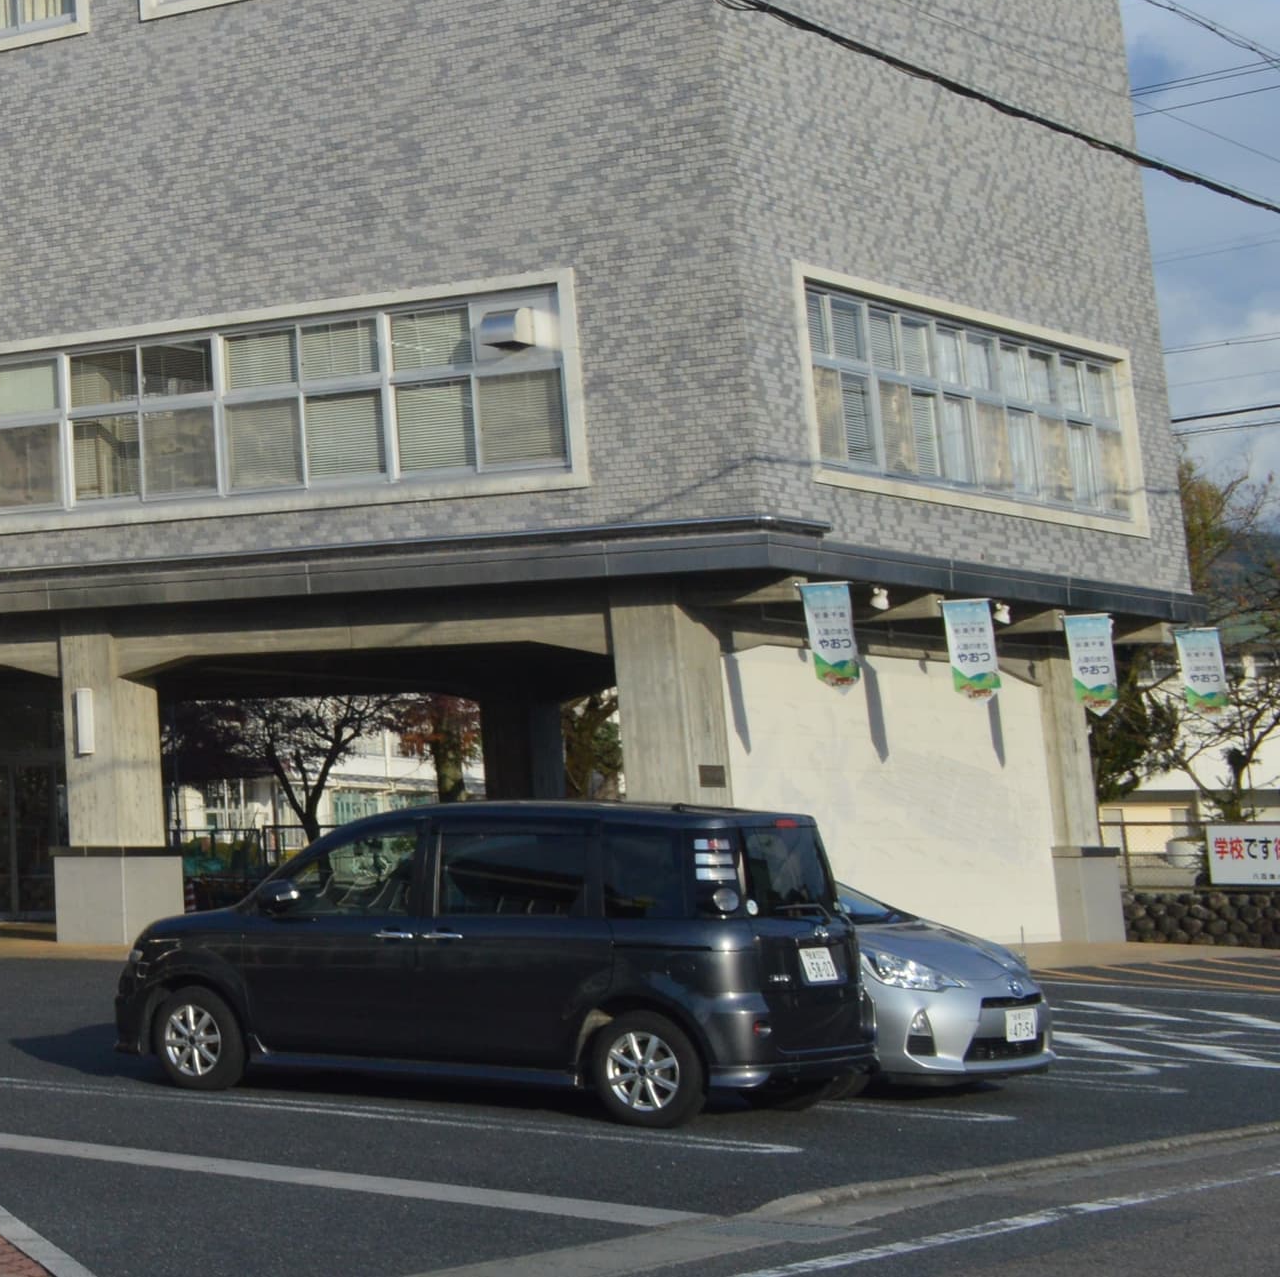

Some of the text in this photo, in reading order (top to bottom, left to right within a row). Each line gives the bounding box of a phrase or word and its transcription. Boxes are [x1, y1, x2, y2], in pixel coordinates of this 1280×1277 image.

[819, 638, 852, 650] やおつ
[957, 652, 991, 663] やおつ
[1078, 665, 1111, 676] やおつ
[1190, 674, 1221, 684] やおつ
[1014, 1021, 1034, 1037] 47-54
